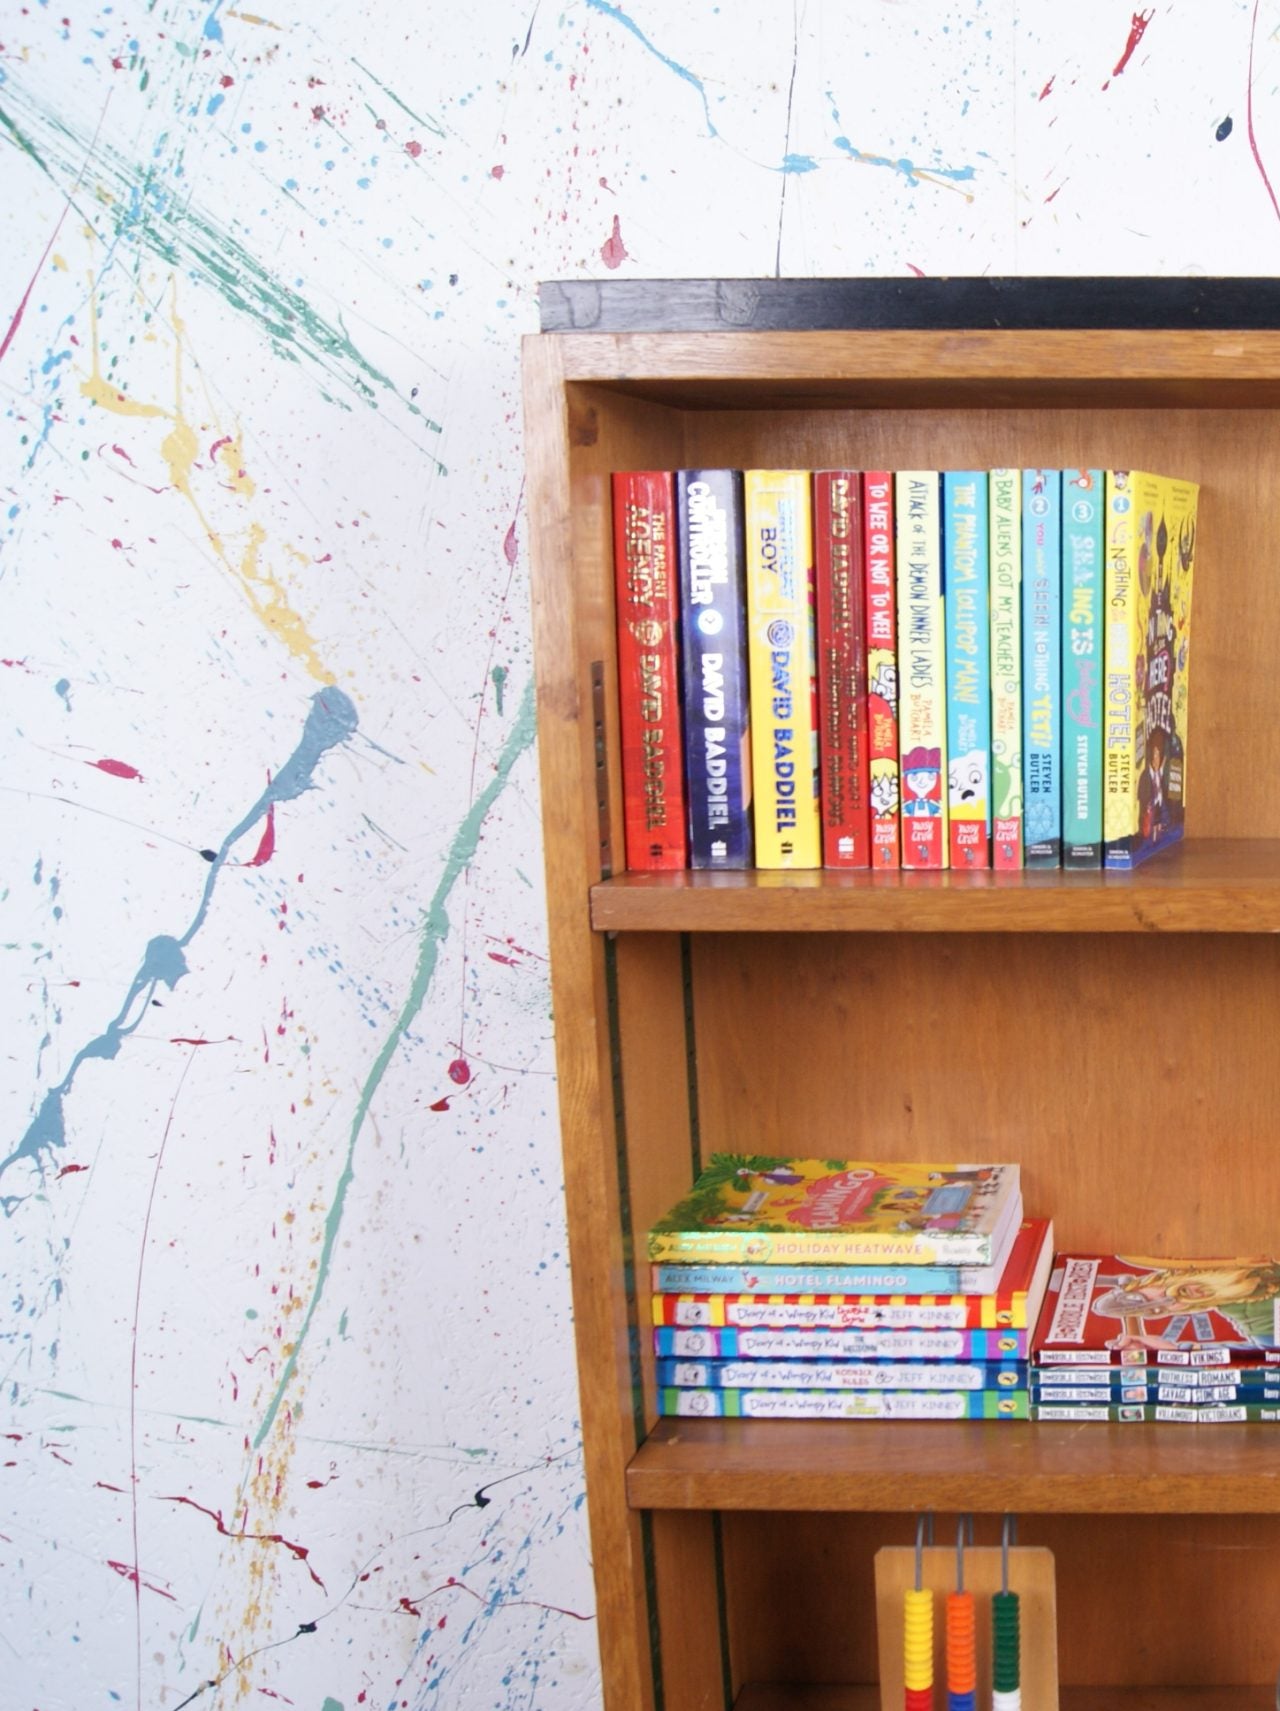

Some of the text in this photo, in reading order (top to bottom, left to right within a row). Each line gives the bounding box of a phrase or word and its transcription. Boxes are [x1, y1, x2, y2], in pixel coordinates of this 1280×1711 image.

[831, 478, 849, 539] DAVID
[868, 481, 889, 499] TO
[908, 479, 930, 520] ATTACK
[994, 479, 1014, 512] BABY
[868, 501, 890, 531] WEE
[996, 514, 1014, 558] ALIENS
[1035, 522, 1046, 546] YOU
[625, 503, 654, 608] AGENCY
[651, 511, 669, 599] THE PARENT
[687, 481, 714, 605] CONTROLLER
[760, 527, 778, 575] BOY
[869, 533, 890, 556] OR
[911, 540, 927, 557] THE
[953, 513, 979, 584] PHANTOM
[869, 558, 891, 587] NOT
[908, 561, 930, 601] DEMON
[997, 562, 1015, 590] GOT
[1110, 547, 1132, 608] NOTHING
[871, 590, 891, 608] TO
[997, 595, 1014, 614] MY
[1032, 577, 1050, 629] SEEN
[910, 604, 932, 645] DINNER
[955, 587, 979, 656] LOLLIPOP
[1070, 627, 1094, 656] IS
[910, 649, 934, 690] LADIES
[1033, 630, 1051, 693] NOTHING
[1150, 655, 1168, 689] HERE
[701, 652, 725, 722] DAVID
[909, 693, 922, 743] BUTCHART
[922, 699, 934, 738] PAMELA
[1107, 673, 1132, 748] HOTEL
[1146, 690, 1172, 741] HOTEL
[639, 653, 666, 832] DAVID BADDIEL
[771, 651, 797, 833] DAVID BADDIEL
[1077, 734, 1089, 776] STEVEN
[703, 726, 730, 831] BADDIEL
[1030, 753, 1040, 794] BUTLER
[1042, 753, 1052, 793] STEVEN
[1108, 753, 1118, 794] BUTLER
[1120, 753, 1130, 793] STEVEN
[1076, 778, 1089, 820] BUTLER
[810, 1168, 876, 1230] FLAMINGO
[776, 1243, 924, 1255] HOLIDAY HEATWAVE
[665, 1275, 734, 1283] ALEX MILWAY
[775, 1274, 908, 1287] HOTEL FLAMINGO
[738, 1307, 766, 1320] Diary
[746, 1337, 774, 1350] Diary
[1193, 1350, 1224, 1363] VIKINGS
[725, 1368, 757, 1382] Diary
[1161, 1372, 1236, 1384] RUTHLESS ROMANS
[1162, 1389, 1187, 1399] SAVAGE
[1218, 1388, 1230, 1399] AGE
[750, 1398, 777, 1410] Diary
[1200, 1408, 1243, 1421] VICTORIANS
